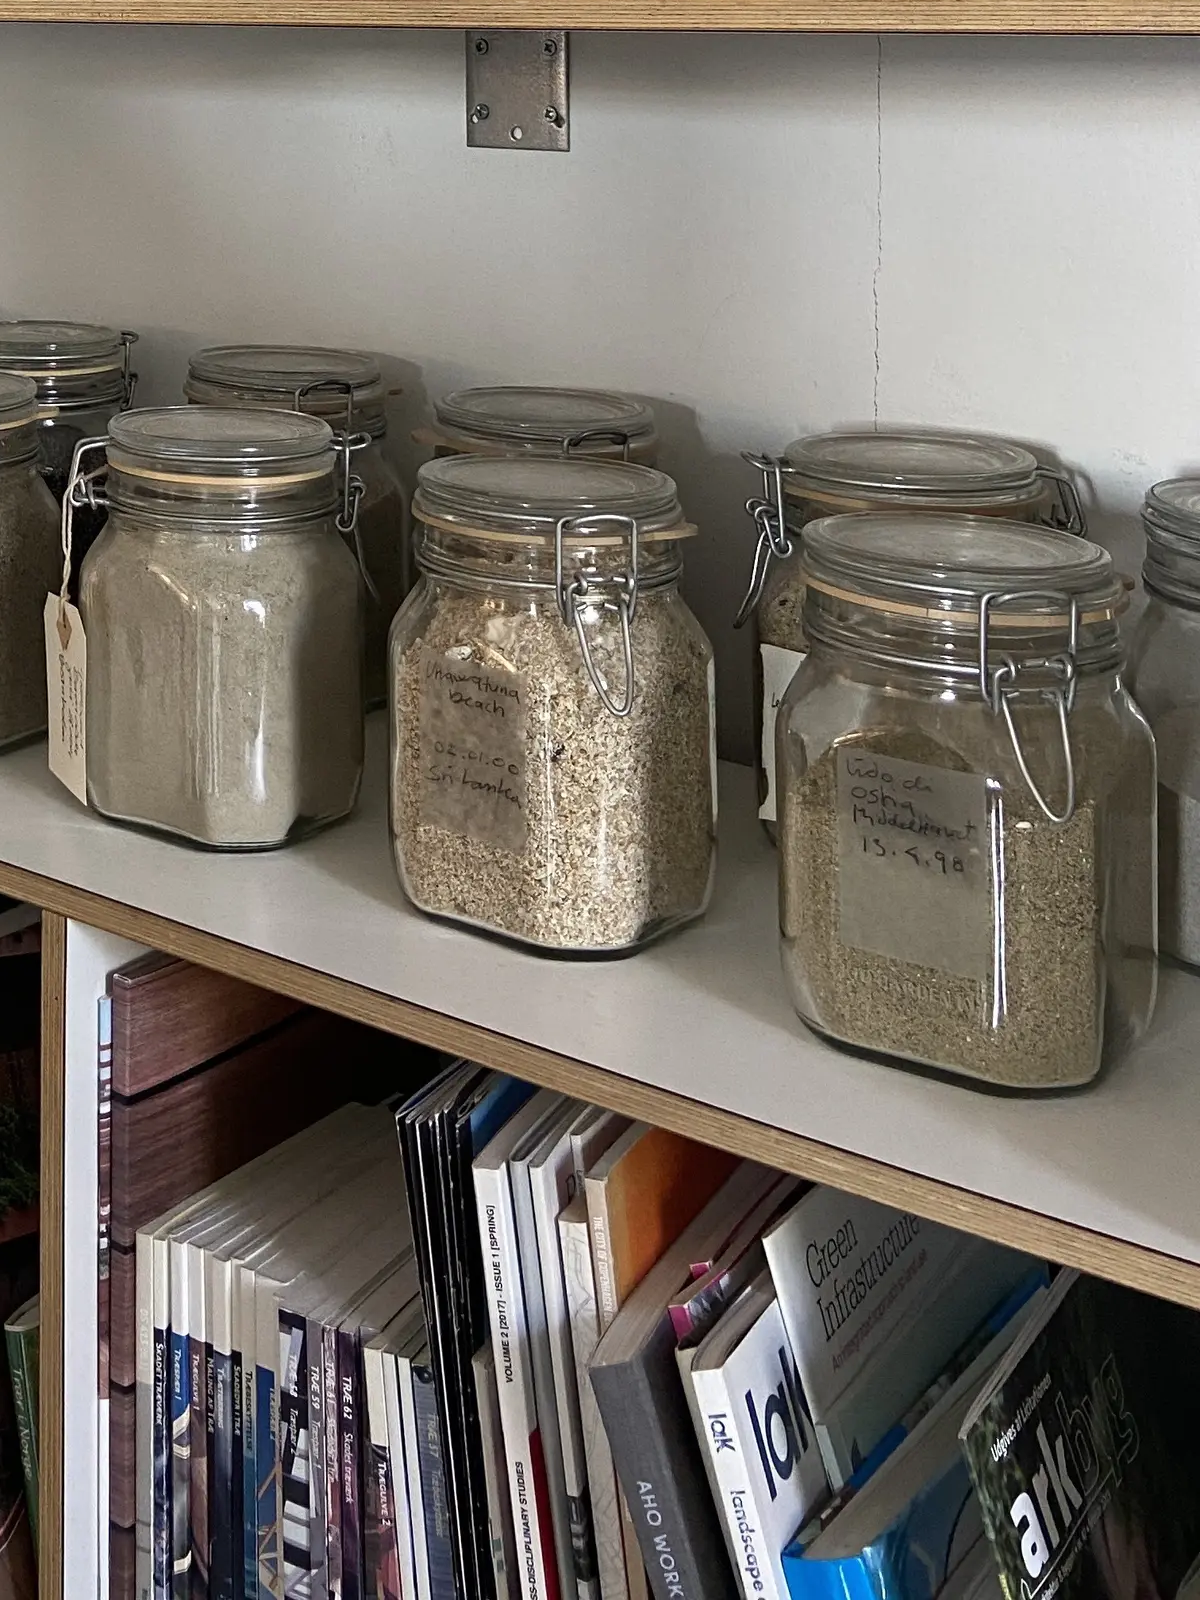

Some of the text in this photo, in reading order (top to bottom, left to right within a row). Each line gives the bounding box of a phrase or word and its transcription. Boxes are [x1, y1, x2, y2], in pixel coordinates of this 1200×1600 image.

[486, 1204, 502, 1251] [SPRING]
[805, 1218, 860, 1289] Green
[494, 1260, 505, 1292] ISSUE
[816, 1213, 922, 1344] Infrastructure
[498, 1298, 509, 1330] [2017]
[310, 1365, 321, 1393] TRÆ
[503, 1340, 514, 1384] VOLUME
[311, 1395, 321, 1410] 59
[341, 1376, 352, 1404] TRÆ
[342, 1406, 352, 1420] 62
[342, 1431, 354, 1464] Skadet
[989, 1424, 1018, 1463] Udgives
[513, 1460, 525, 1499] STUDIES
[1008, 1353, 1141, 1580] arkbyg
[636, 1480, 663, 1529] AHO
[707, 1413, 765, 1592] lak landscape
